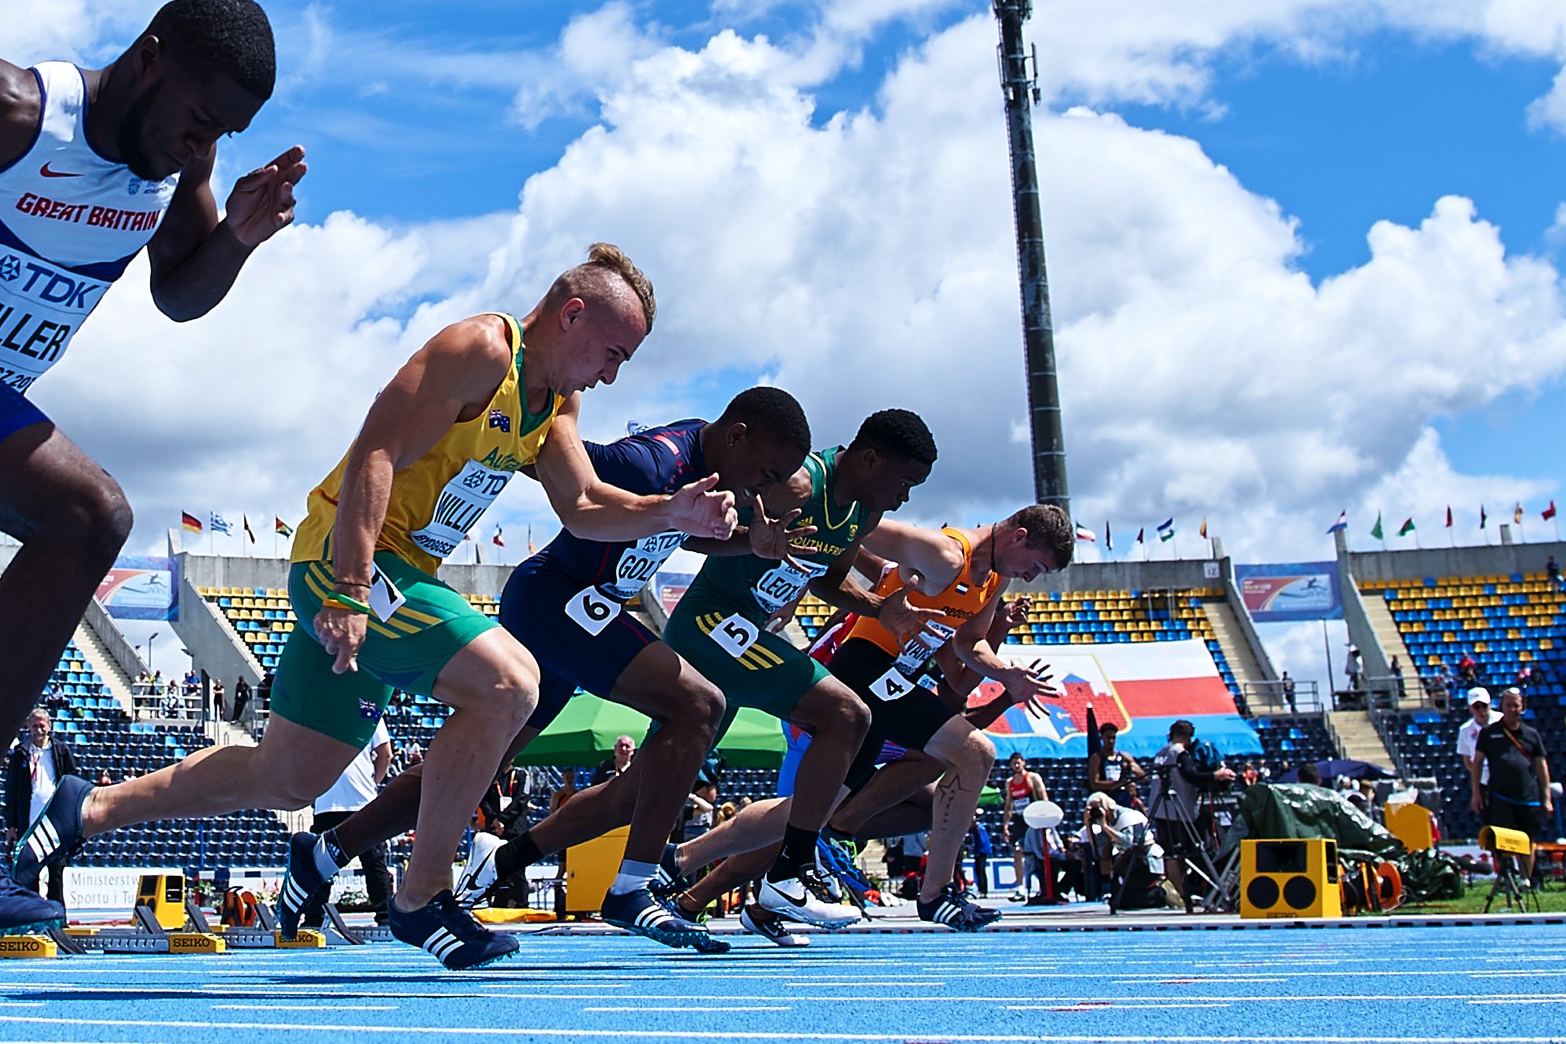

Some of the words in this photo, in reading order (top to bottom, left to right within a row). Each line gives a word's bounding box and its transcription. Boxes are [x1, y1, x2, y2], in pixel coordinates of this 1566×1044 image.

[16, 192, 88, 223] GREAT
[87, 206, 161, 232] BRITAIN
[22, 262, 100, 309] TDK
[481, 474, 511, 496] TD
[372, 567, 398, 605] 7
[583, 594, 611, 621] 6
[723, 621, 750, 647] 5
[886, 677, 905, 696] 4
[70, 873, 139, 886] Ministerstw
[70, 892, 109, 907] Sportu
[0, 941, 40, 952] SEIKO
[173, 938, 211, 948] SEIKO
[278, 934, 313, 943] SIKO
